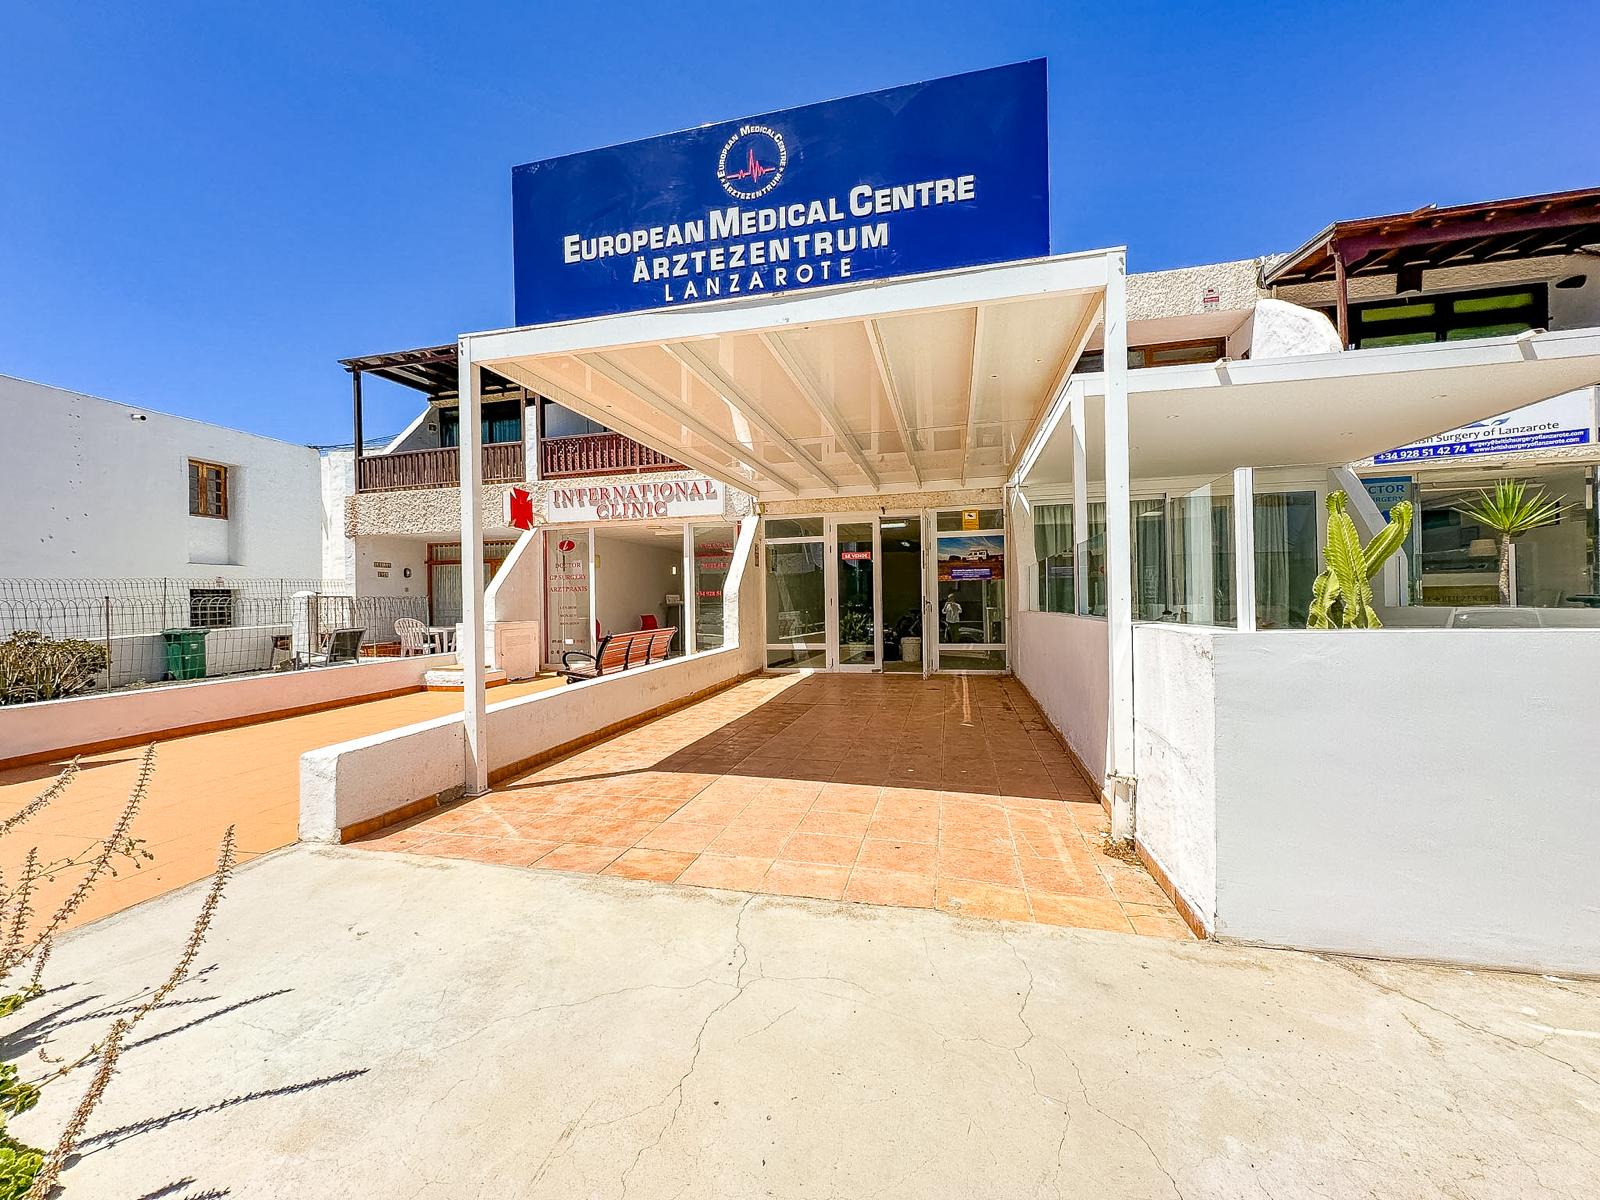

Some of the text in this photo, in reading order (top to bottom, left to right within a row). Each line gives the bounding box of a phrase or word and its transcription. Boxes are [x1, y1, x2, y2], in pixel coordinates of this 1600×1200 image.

[717, 125, 787, 179] EUROPEAN MEDICAL CENTRE
[564, 174, 976, 264] EUROPEAN MEDICAL CENTRE
[632, 222, 889, 283] ÄRZTEZENTRUM
[665, 257, 851, 302] LANZAROTE
[1436, 431, 1480, 443] Surgery
[1483, 427, 1495, 437] of
[1498, 421, 1560, 435] Lanzarote
[1378, 445, 1467, 461] +34 928 51 42 74
[553, 480, 718, 505] INTERNATIONAL
[1368, 484, 1405, 494] CTOR
[596, 501, 668, 520] CLINIC
